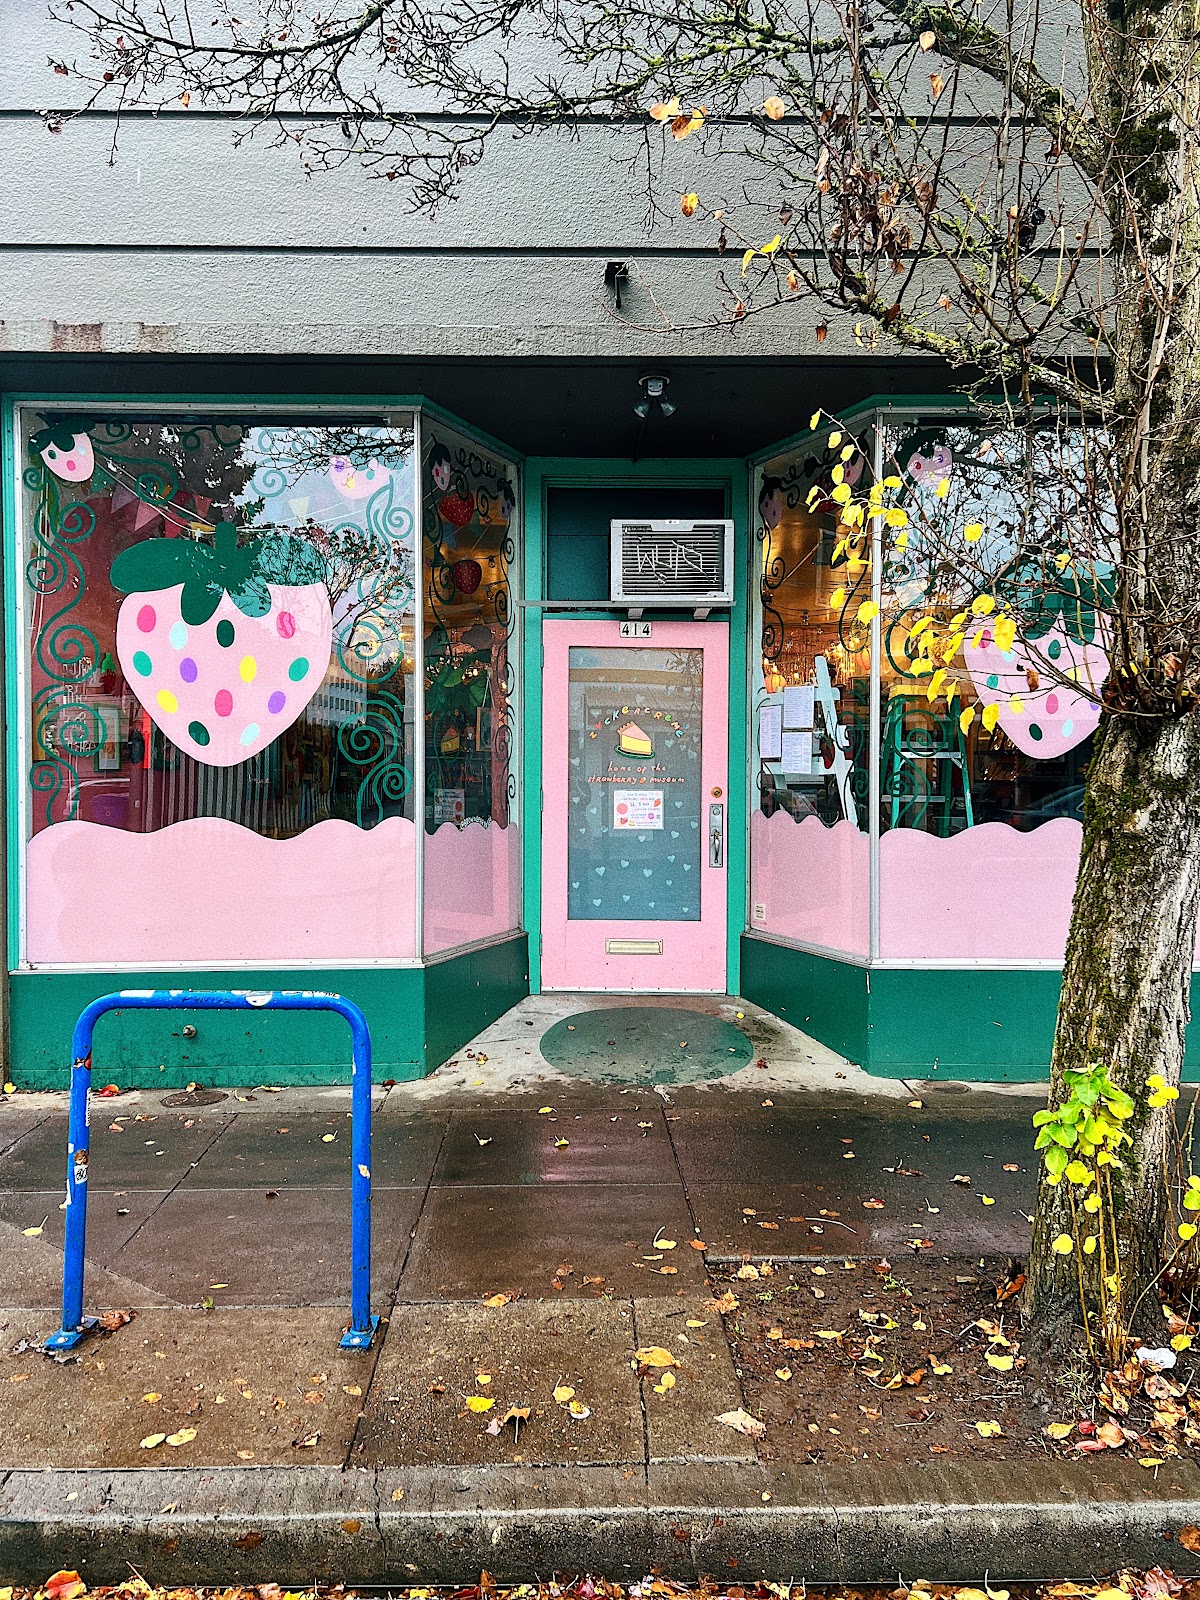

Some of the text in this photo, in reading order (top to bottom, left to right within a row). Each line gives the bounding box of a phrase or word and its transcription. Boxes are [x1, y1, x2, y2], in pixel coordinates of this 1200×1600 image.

[621, 623, 650, 636] 414
[608, 761, 667, 774] home of the
[588, 774, 637, 785] strawberry
